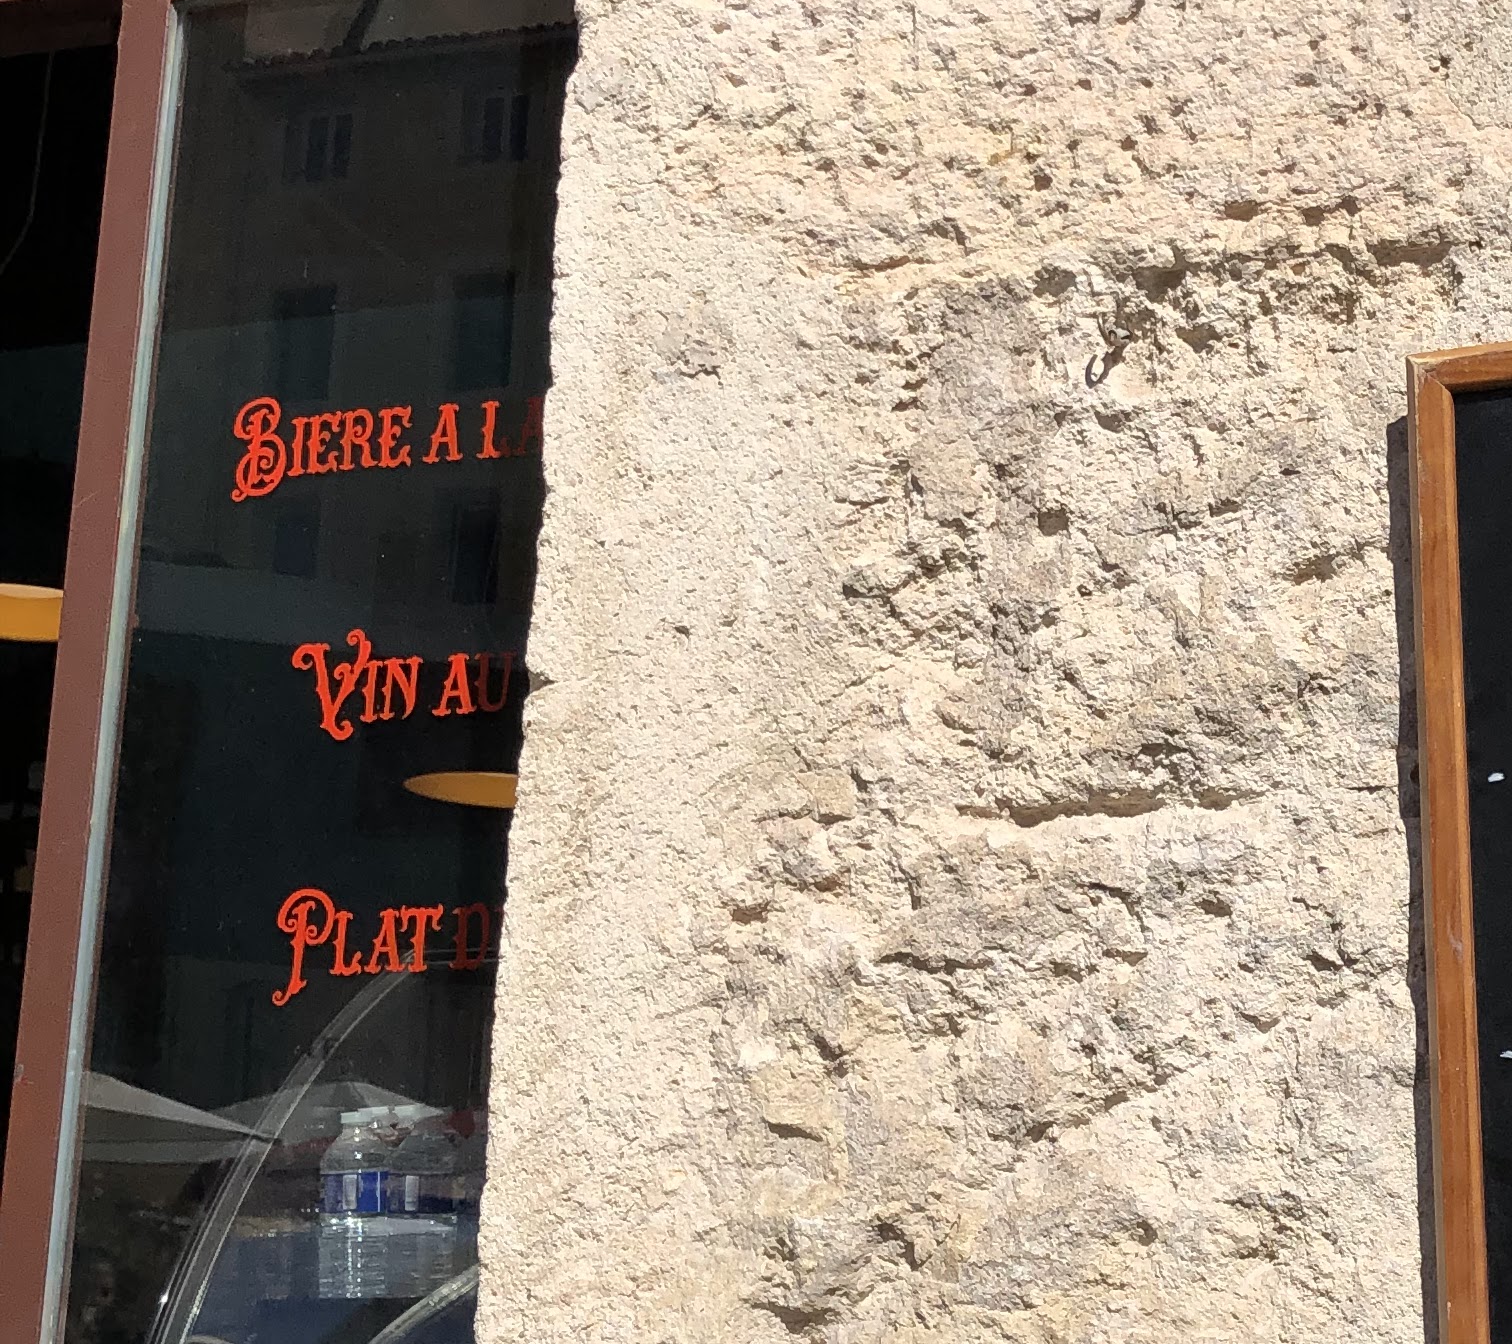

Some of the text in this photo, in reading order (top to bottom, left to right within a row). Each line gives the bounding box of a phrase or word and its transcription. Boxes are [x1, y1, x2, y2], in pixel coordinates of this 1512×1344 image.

[231, 396, 412, 502] BIERE
[422, 403, 464, 465] A
[291, 628, 517, 741] VIN AU
[271, 887, 444, 1007] PLAT
